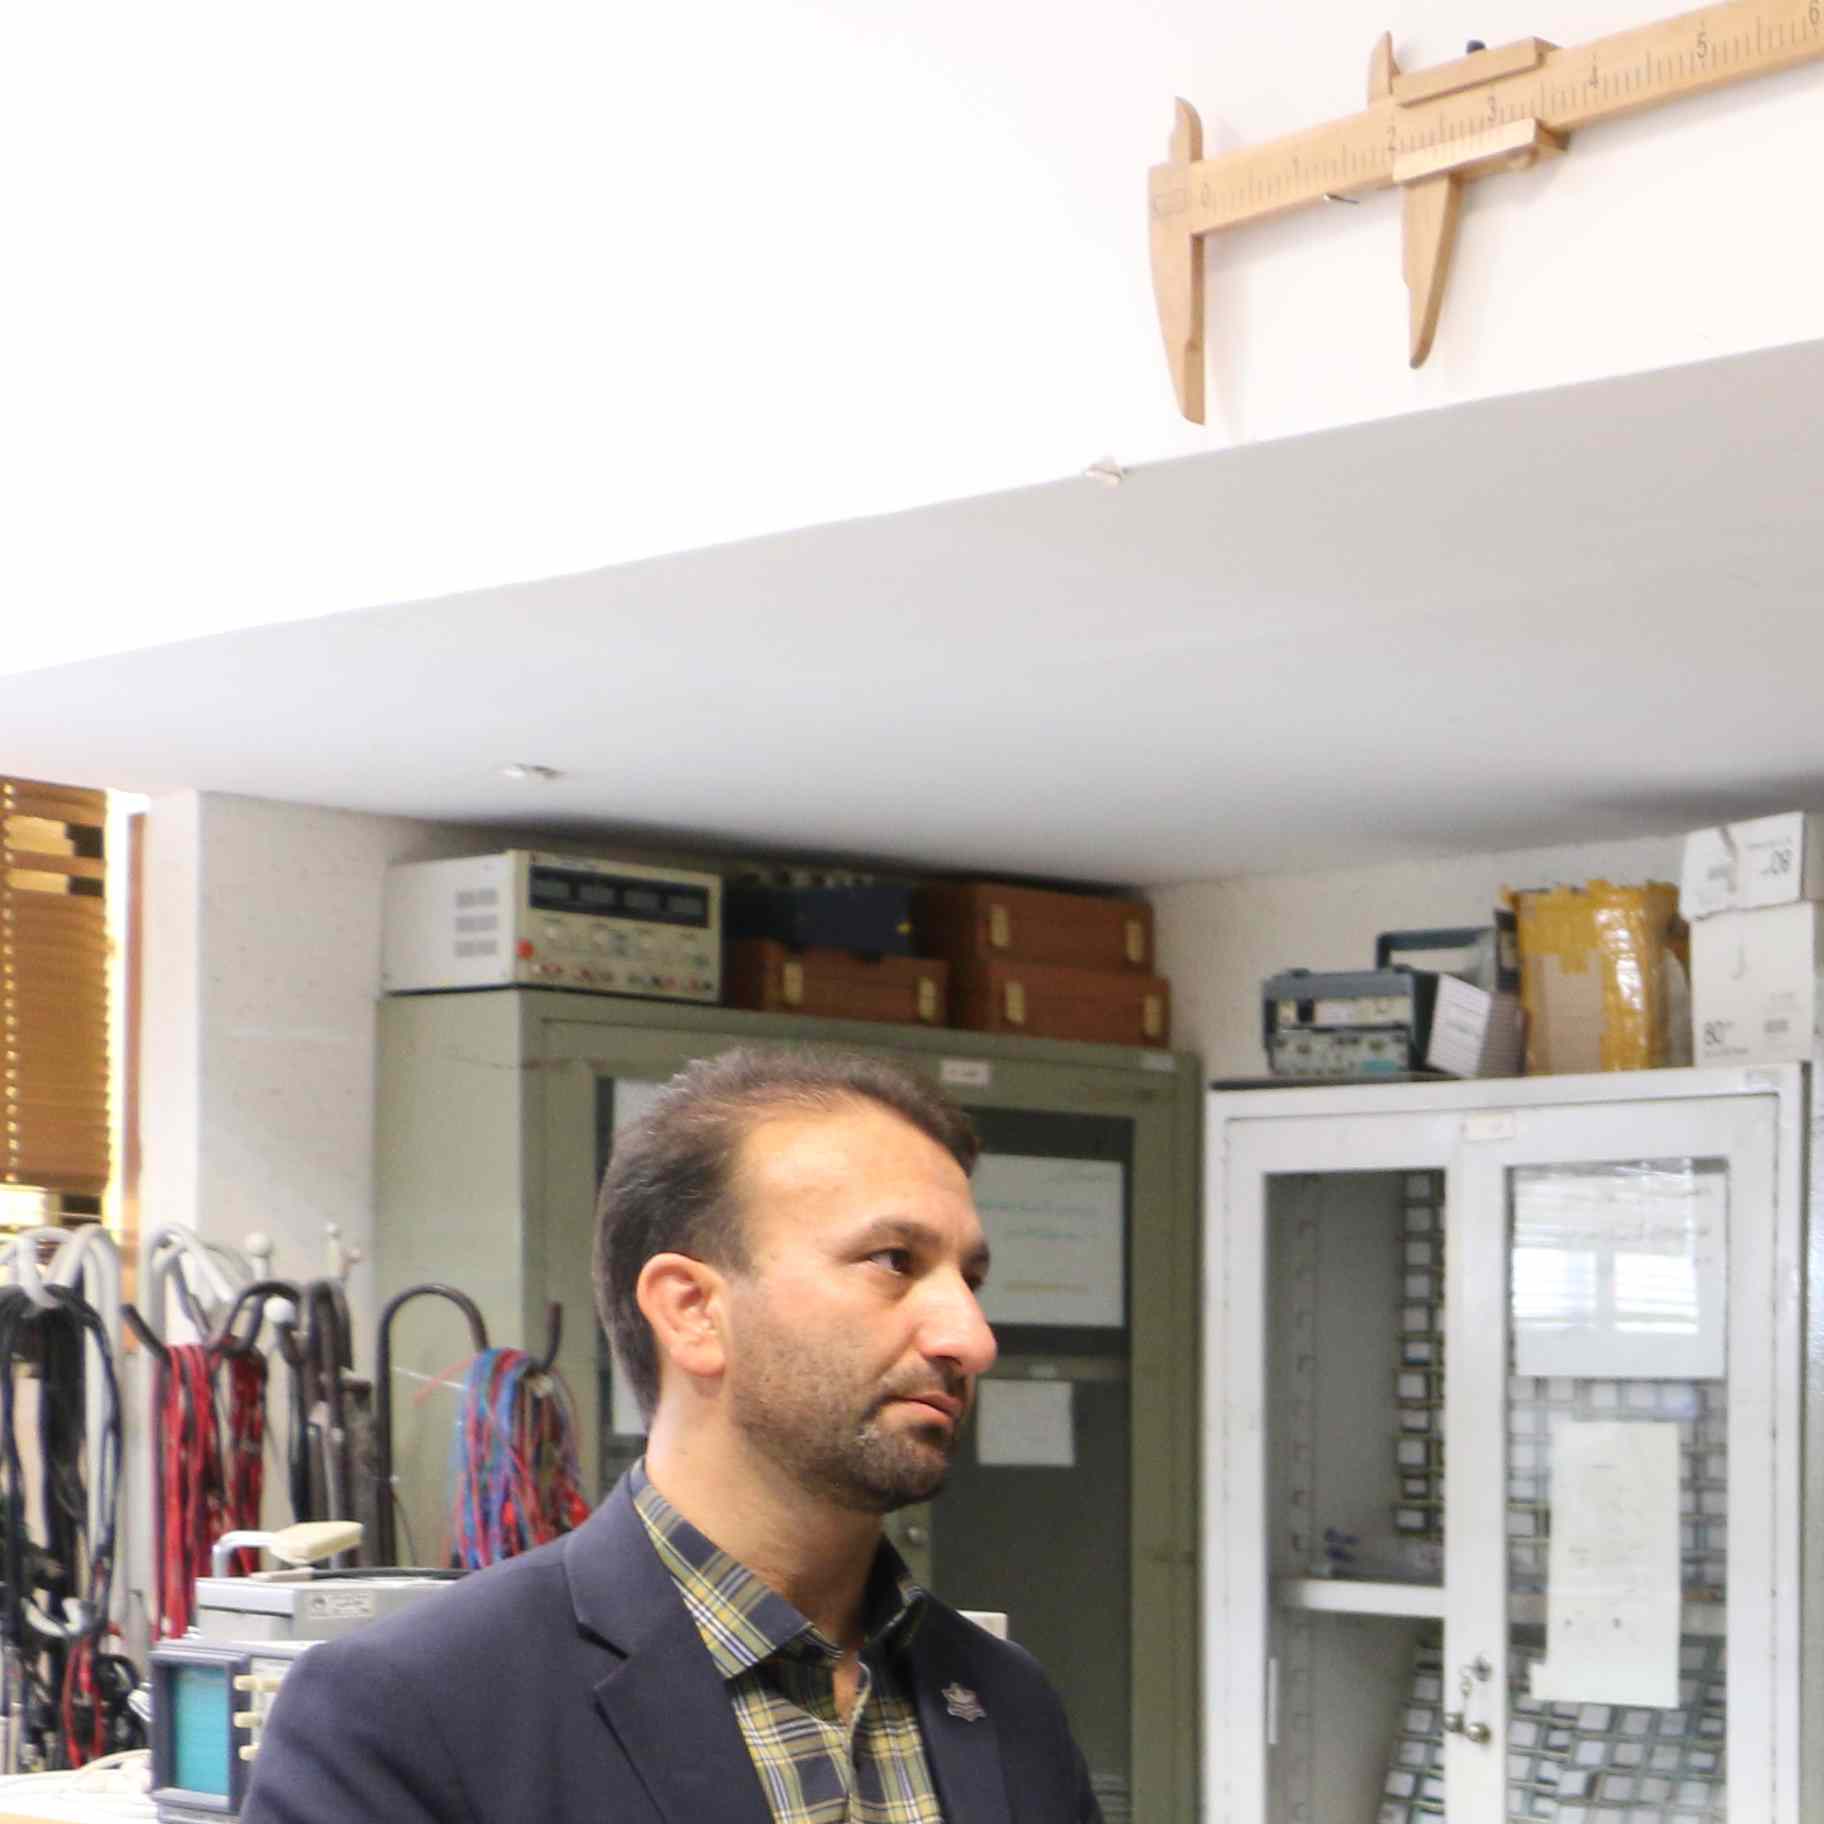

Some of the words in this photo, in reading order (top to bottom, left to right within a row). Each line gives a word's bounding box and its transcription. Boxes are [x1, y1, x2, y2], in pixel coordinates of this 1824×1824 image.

[1386, 124, 1397, 151] 2
[1487, 95, 1498, 122] 3
[1695, 31, 1708, 58] 5
[1808, 0, 1821, 25] 6
